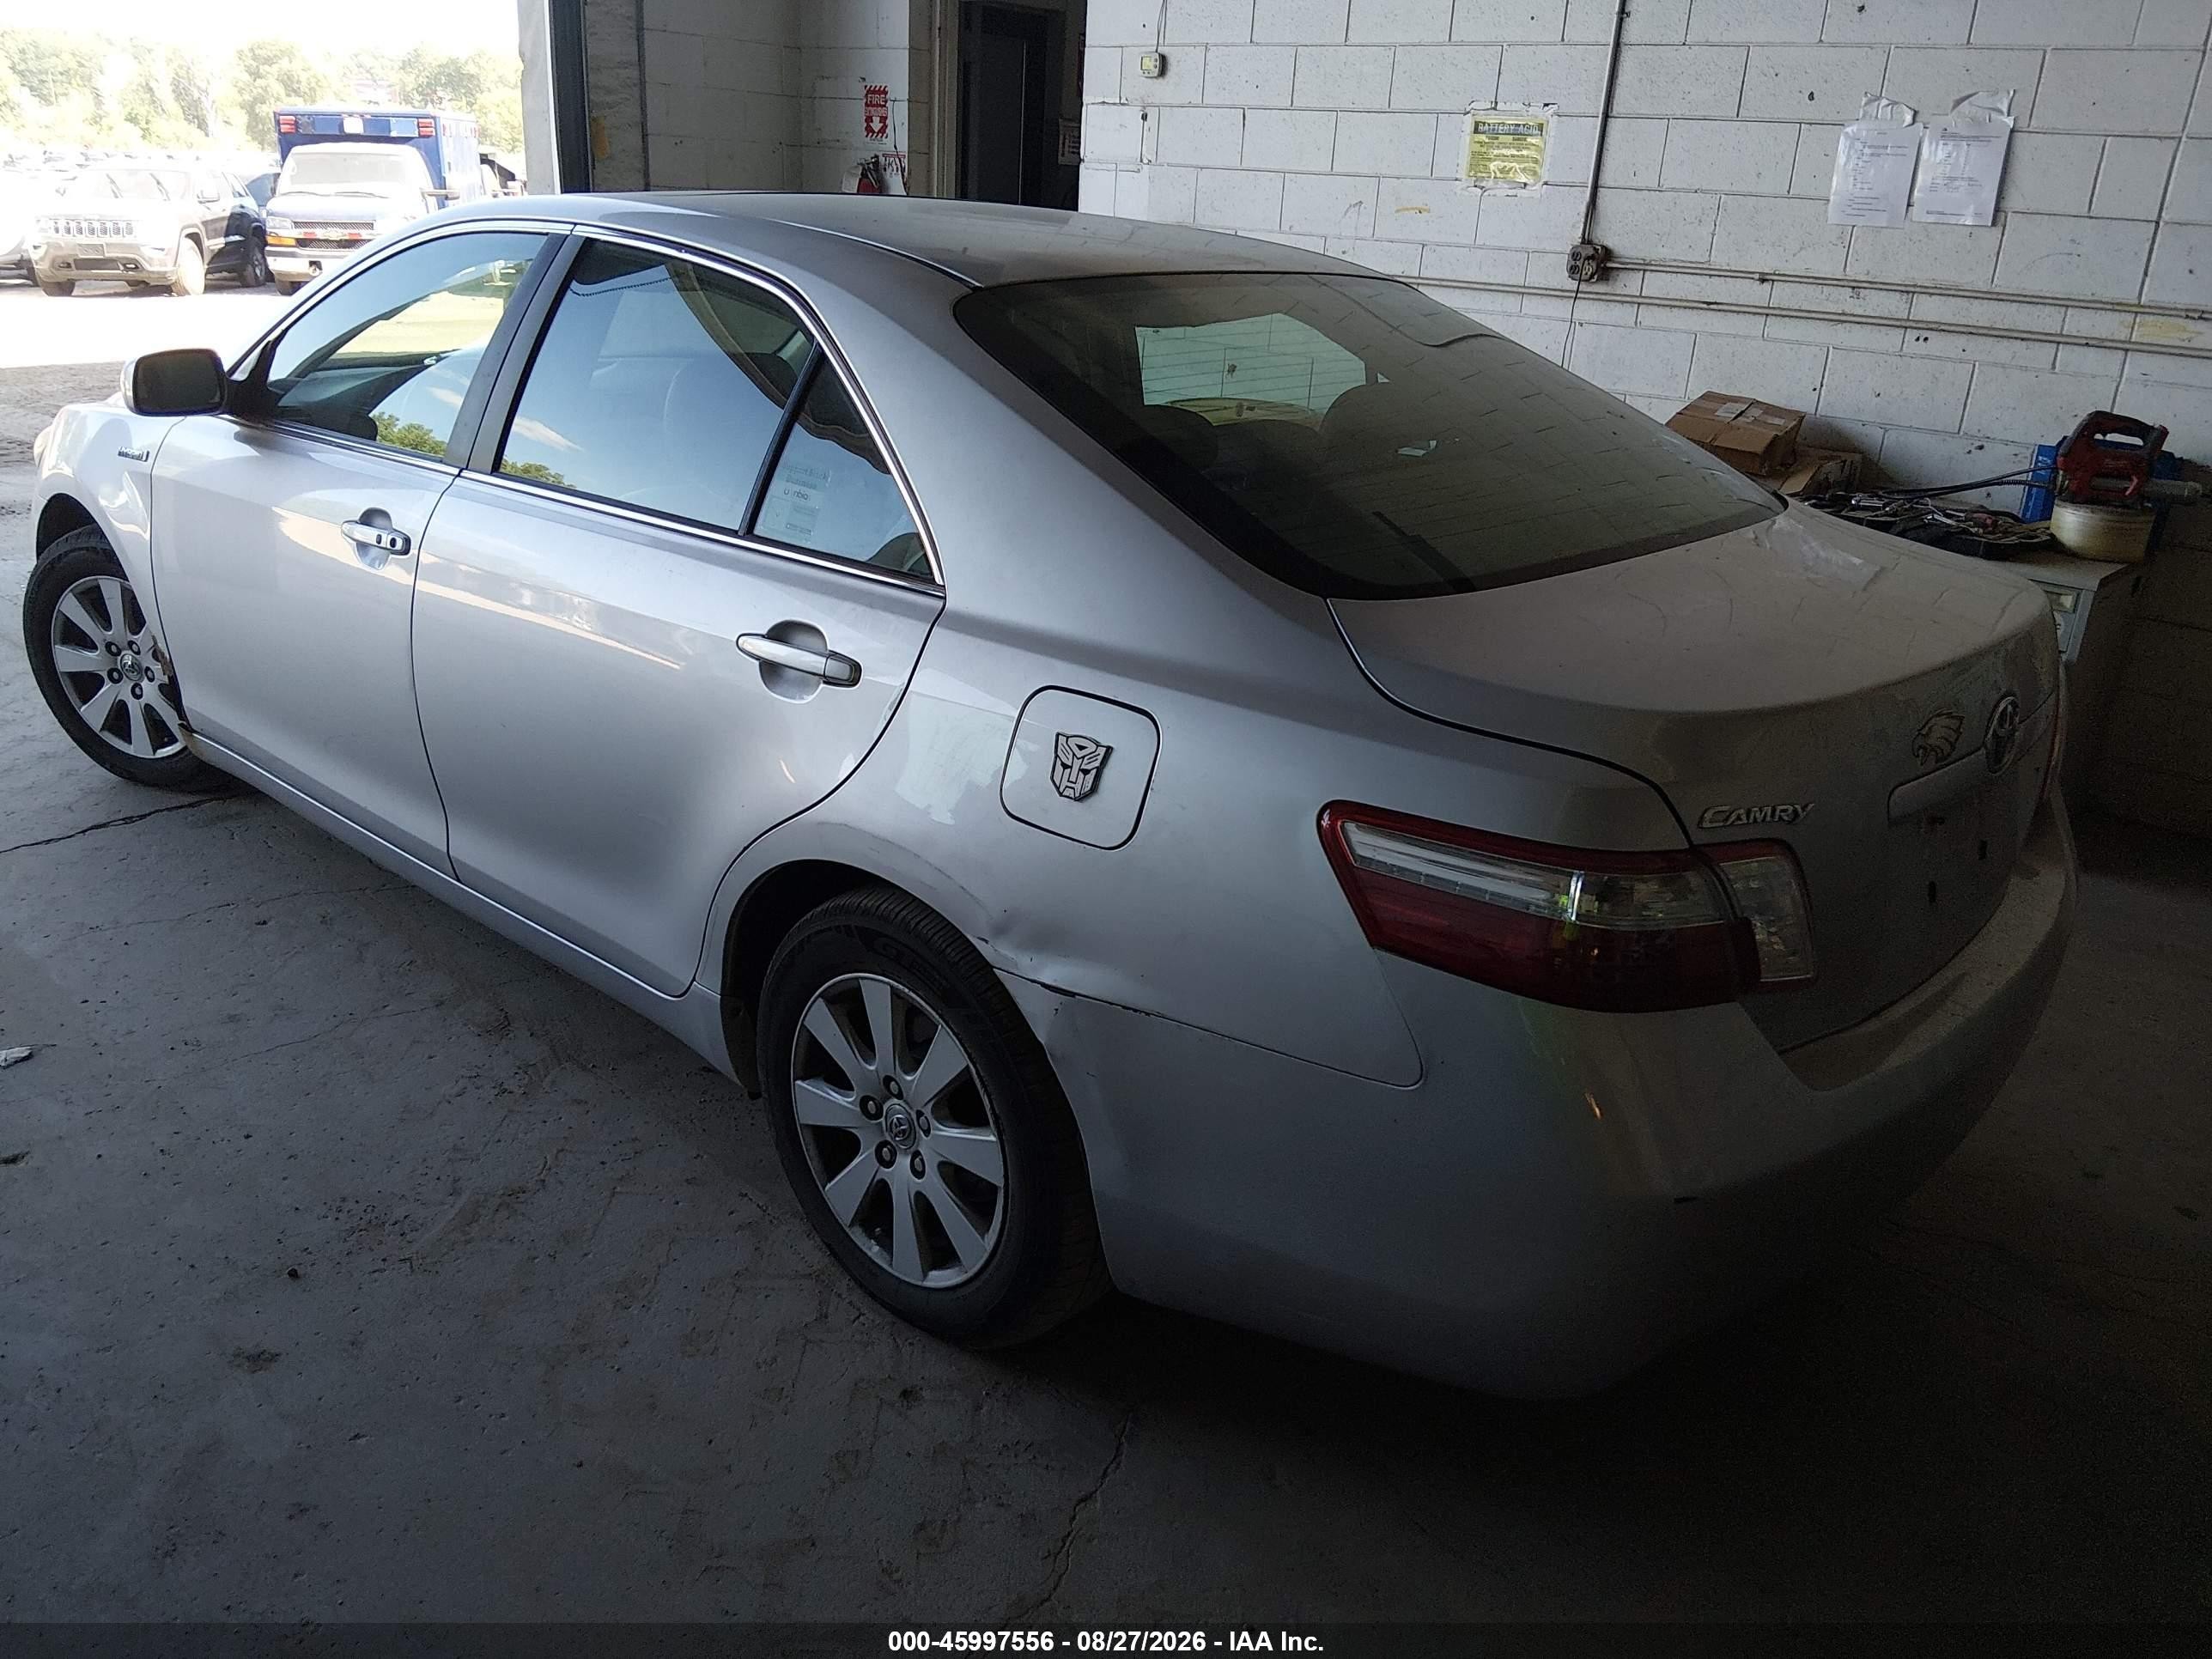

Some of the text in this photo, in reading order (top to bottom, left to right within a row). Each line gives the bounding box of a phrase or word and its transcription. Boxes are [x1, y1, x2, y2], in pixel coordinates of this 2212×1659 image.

[867, 94, 885, 105] FIRE
[1478, 123, 1540, 135] BATTERY ACID
